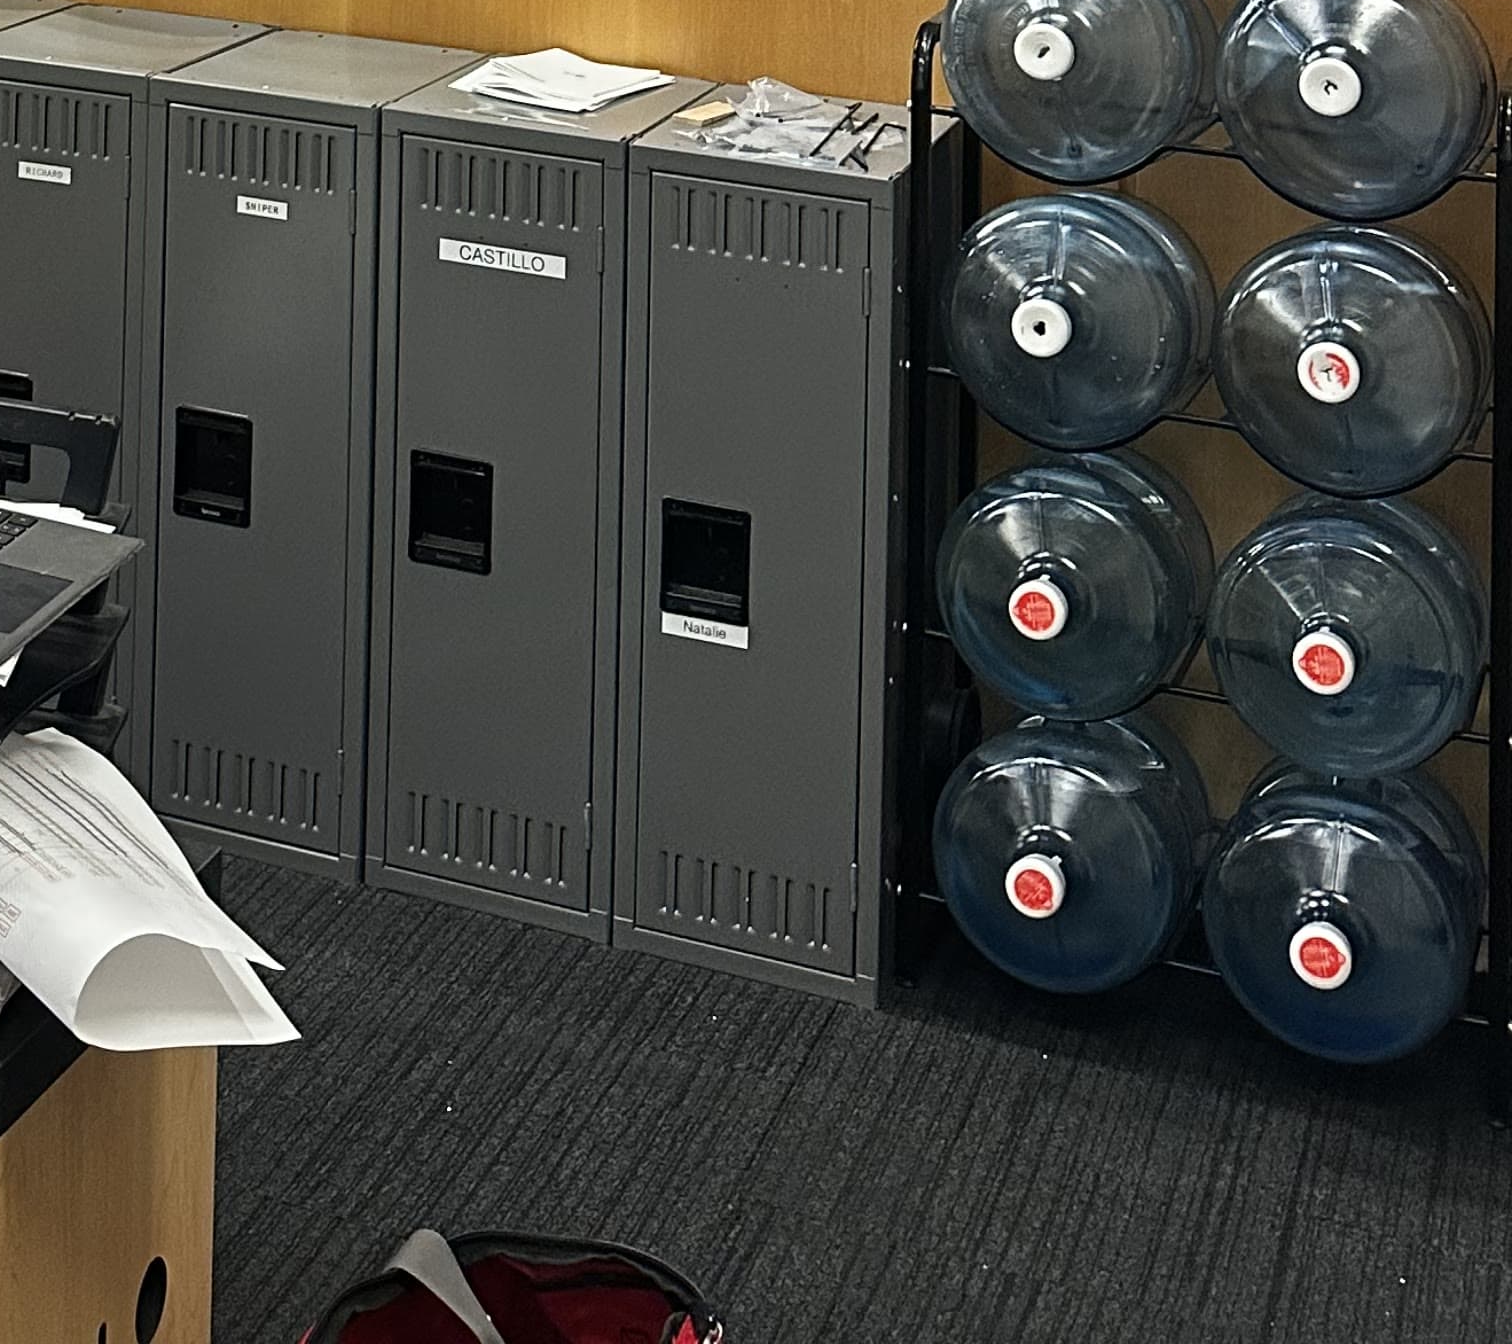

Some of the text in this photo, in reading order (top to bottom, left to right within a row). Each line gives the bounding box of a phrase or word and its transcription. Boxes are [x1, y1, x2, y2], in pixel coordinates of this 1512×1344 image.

[245, 201, 279, 215] SNIPER
[458, 244, 545, 272] CASTILLO
[683, 619, 727, 640] Natalie
